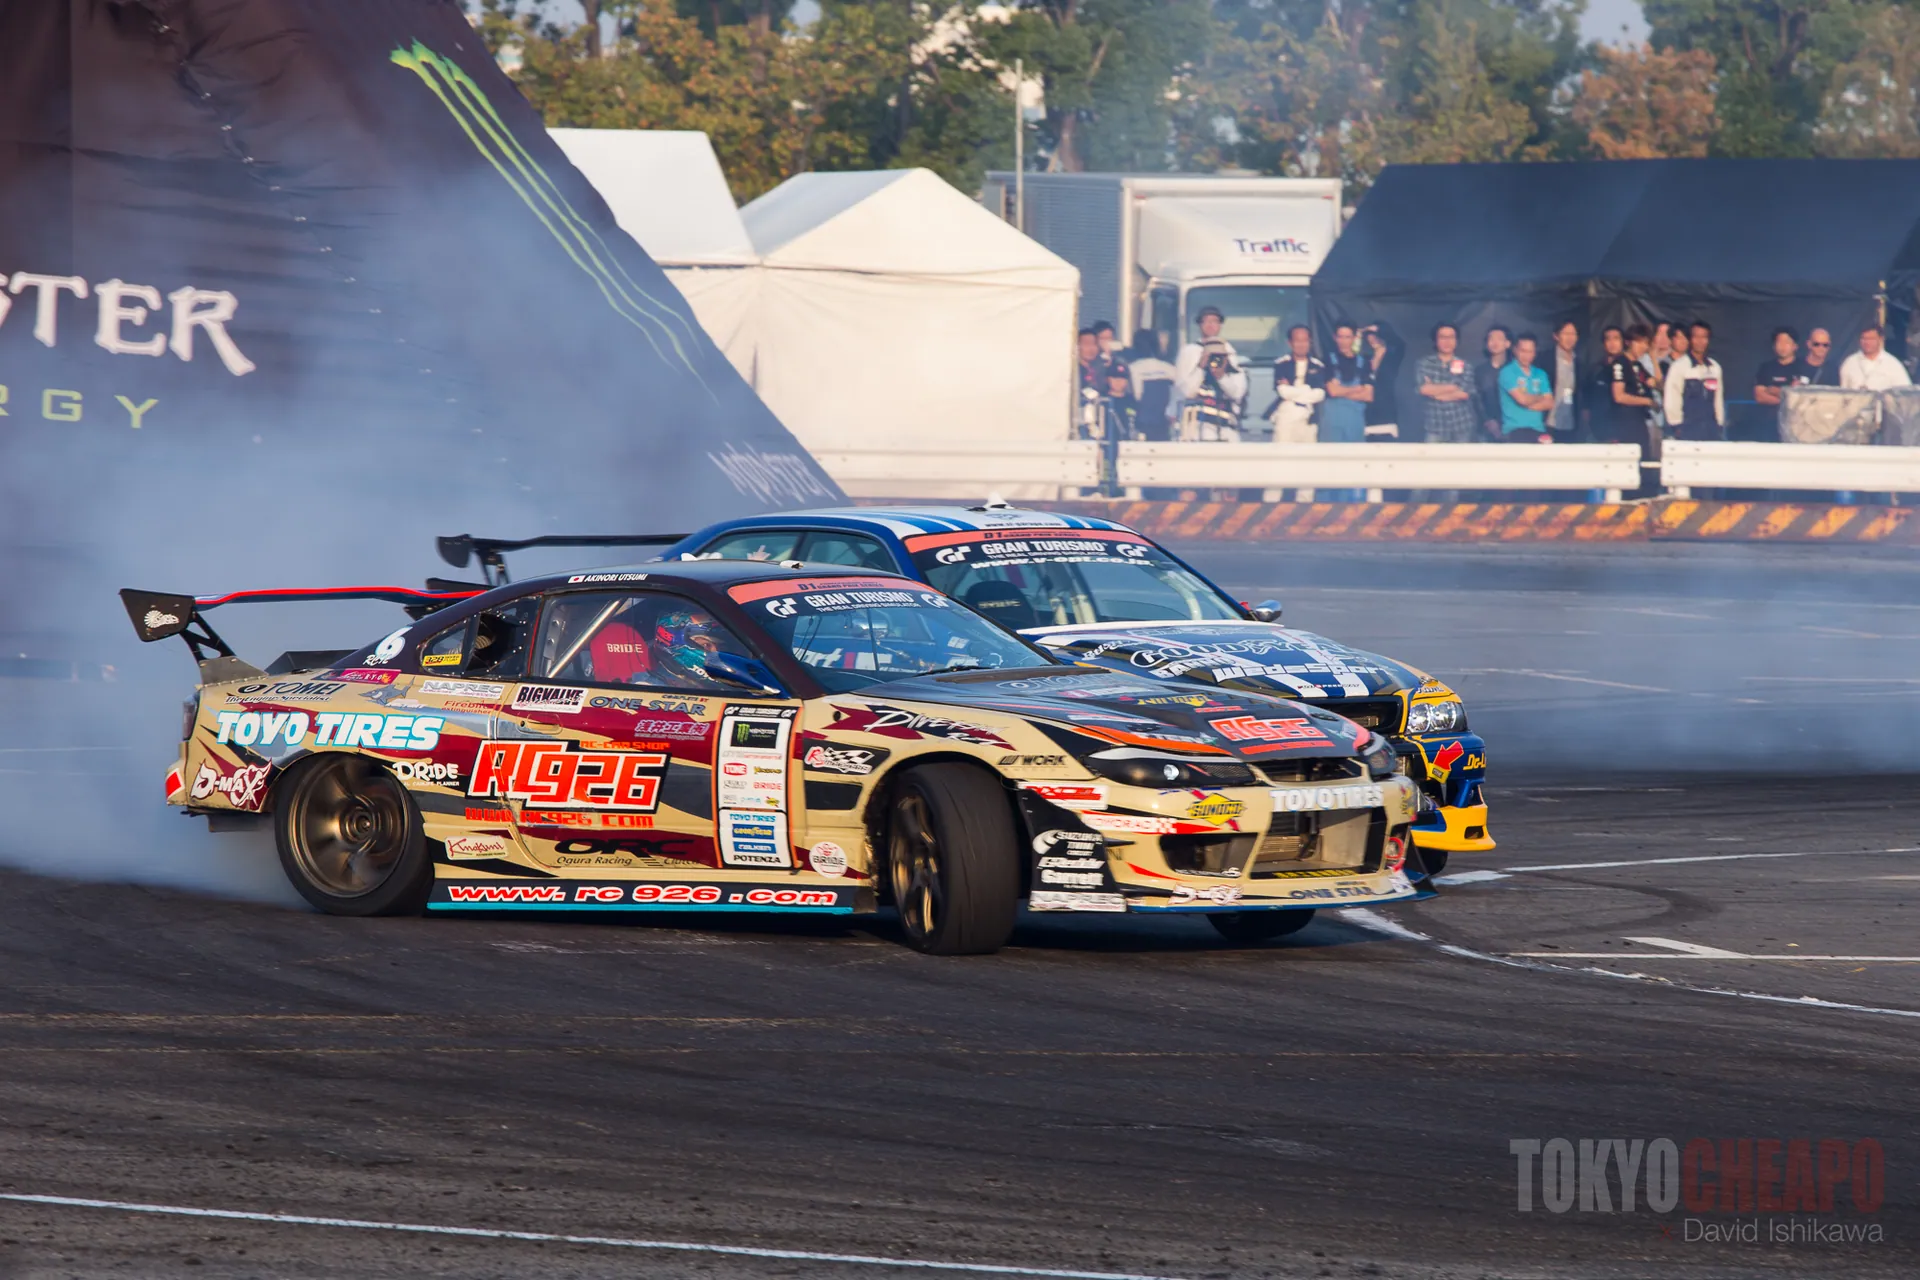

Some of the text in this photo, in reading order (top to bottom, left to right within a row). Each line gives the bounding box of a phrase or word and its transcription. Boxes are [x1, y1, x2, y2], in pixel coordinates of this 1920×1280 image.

[1232, 238, 1310, 254] Traffic
[980, 541, 1106, 555] GRAN TURISMO
[803, 592, 909, 608] GRAN TURISMO
[374, 626, 413, 660] 6
[607, 643, 644, 654] BRIDE
[263, 682, 347, 695] TOMEI
[424, 681, 503, 694] NAPREC
[590, 696, 643, 710] ONE
[648, 699, 706, 716] STAR
[217, 711, 446, 750] TOYO TIRES
[1020, 755, 1068, 766] WORK
[470, 742, 664, 808] RC926
[191, 759, 272, 807] D-MAX
[753, 782, 782, 790] BRIDE
[1189, 802, 1243, 817] SUNOCO
[730, 813, 751, 821] TOYO
[554, 838, 695, 858] ORC
[556, 856, 594, 867] Ogura
[596, 856, 633, 867] Racing
[733, 855, 781, 863] POTENZA
[812, 855, 846, 866] BRIDE
[1289, 887, 1374, 900] ONE STAR
